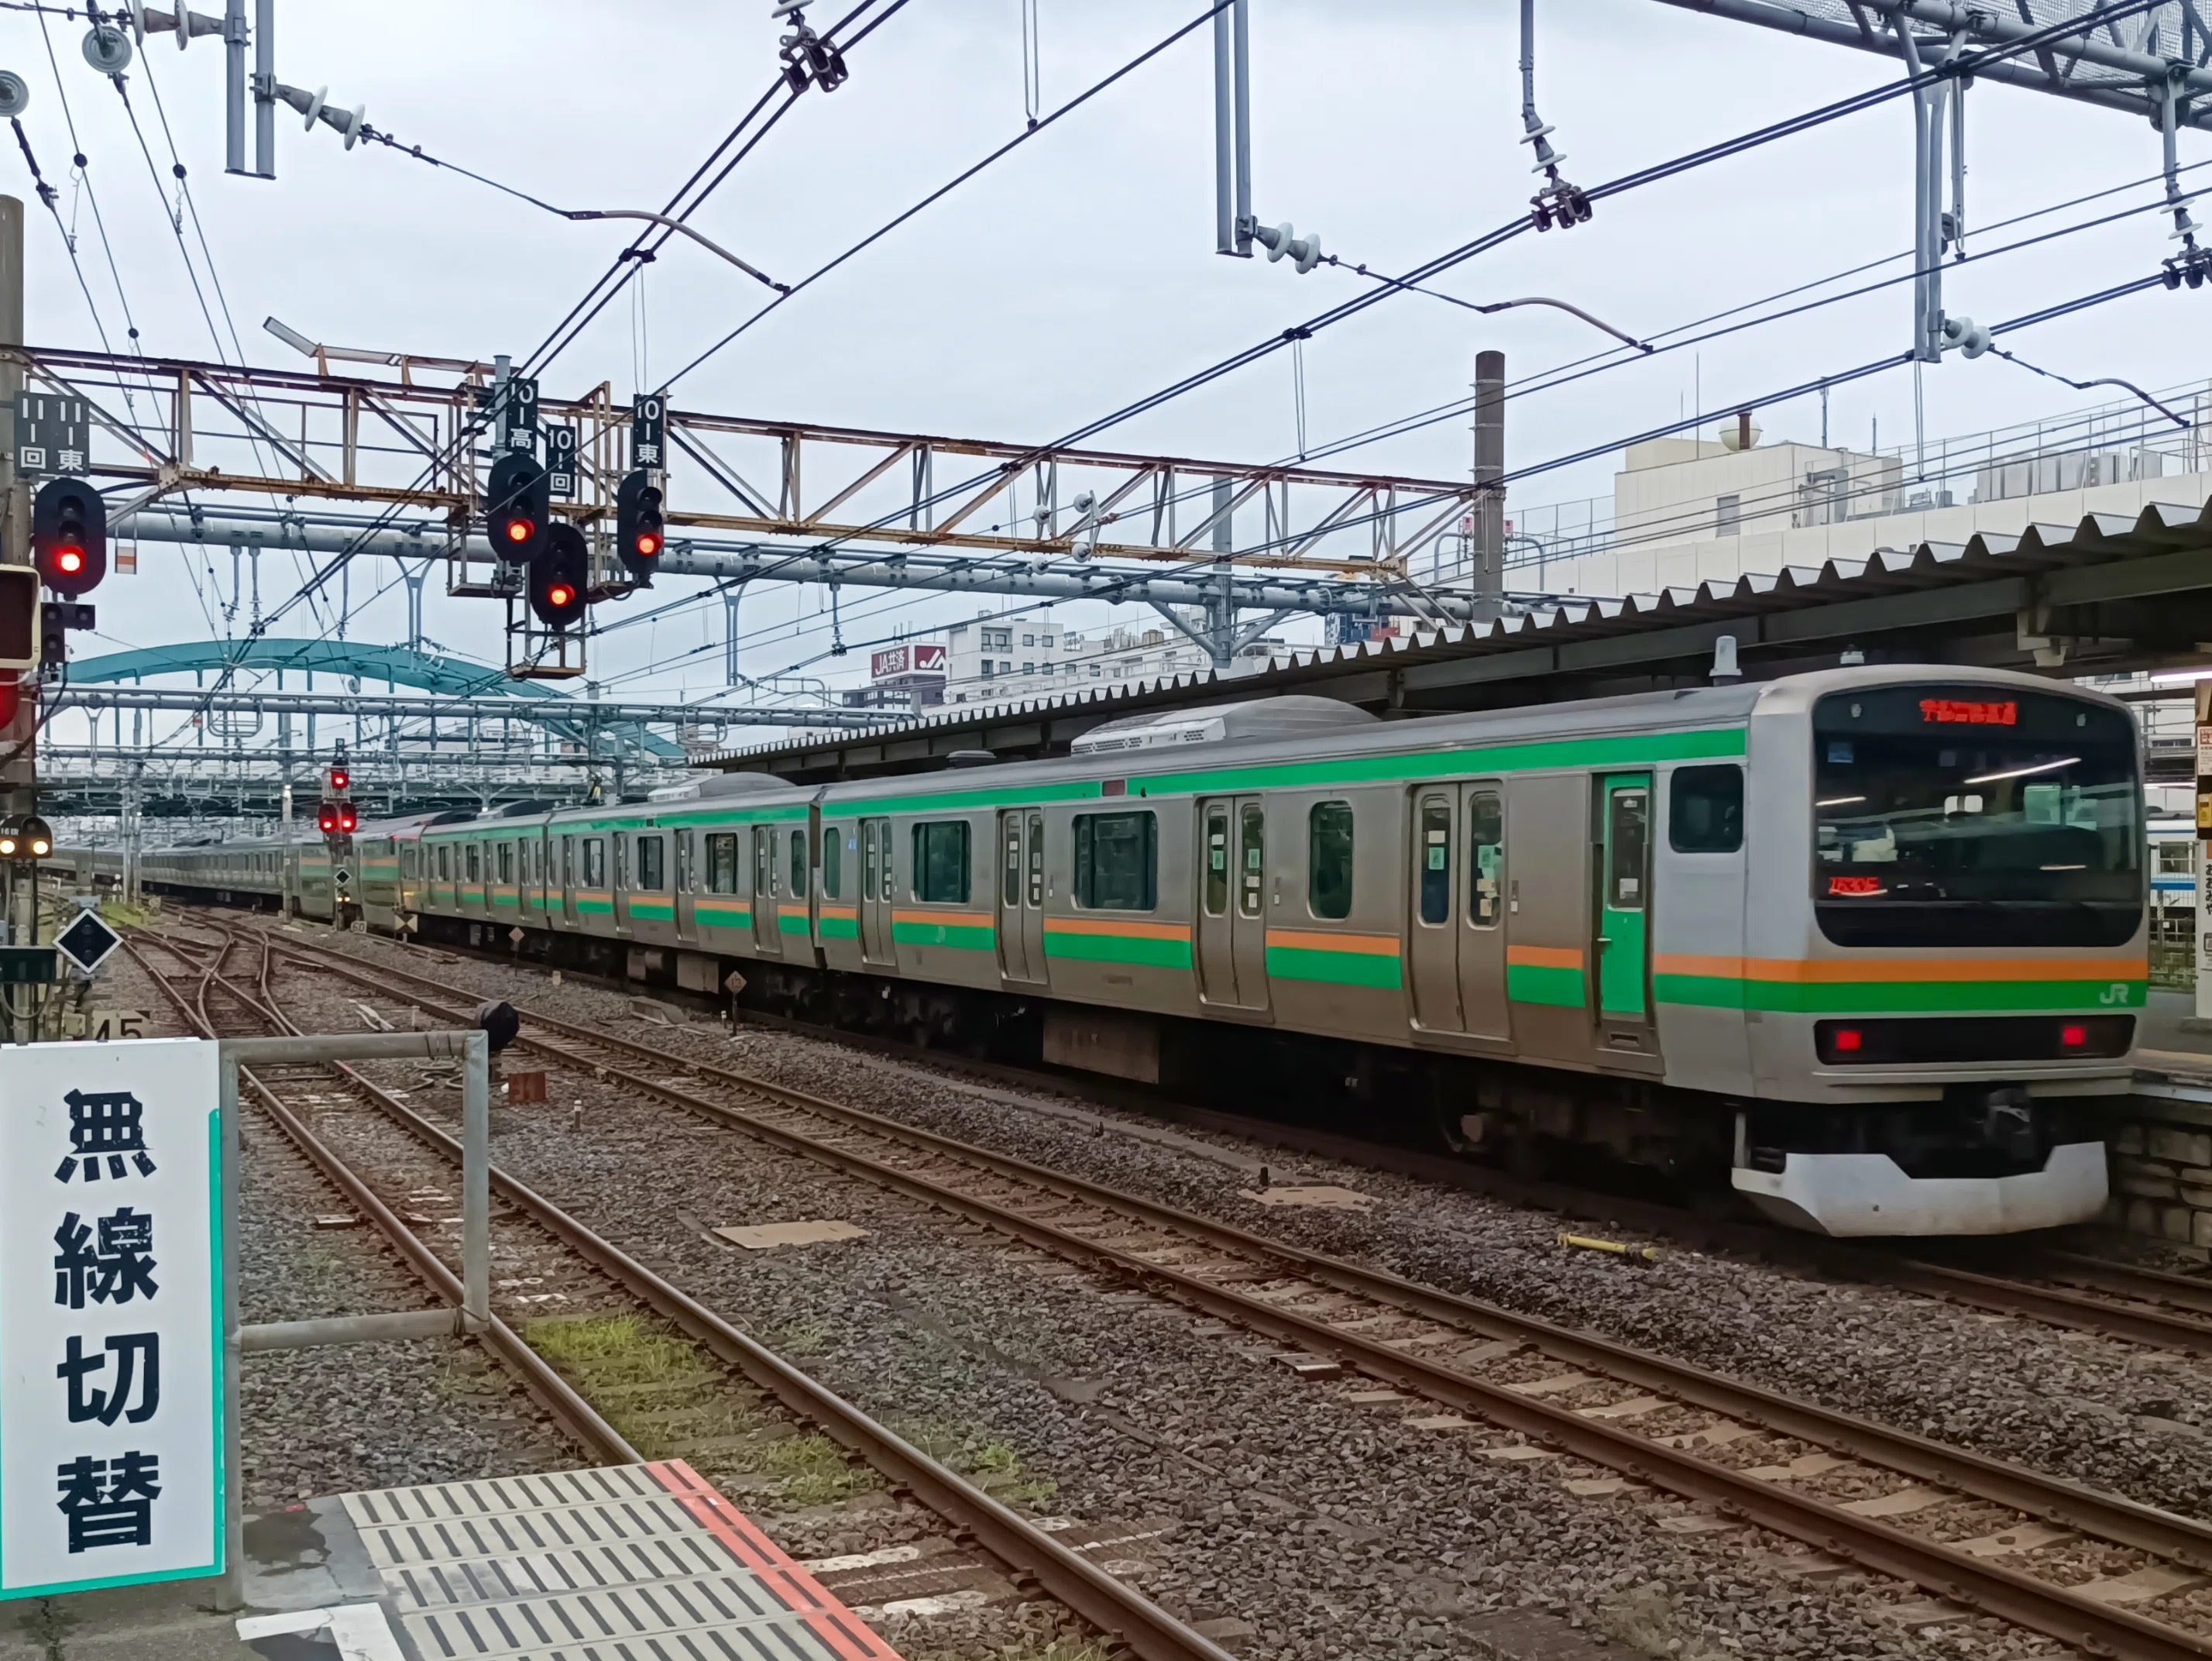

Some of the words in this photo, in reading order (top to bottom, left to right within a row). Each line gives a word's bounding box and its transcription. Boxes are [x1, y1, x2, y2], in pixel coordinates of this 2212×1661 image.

[874, 648, 905, 676] JA共済
[2100, 983, 2129, 1004] JR
[54, 1088, 163, 1554] 無線切替
